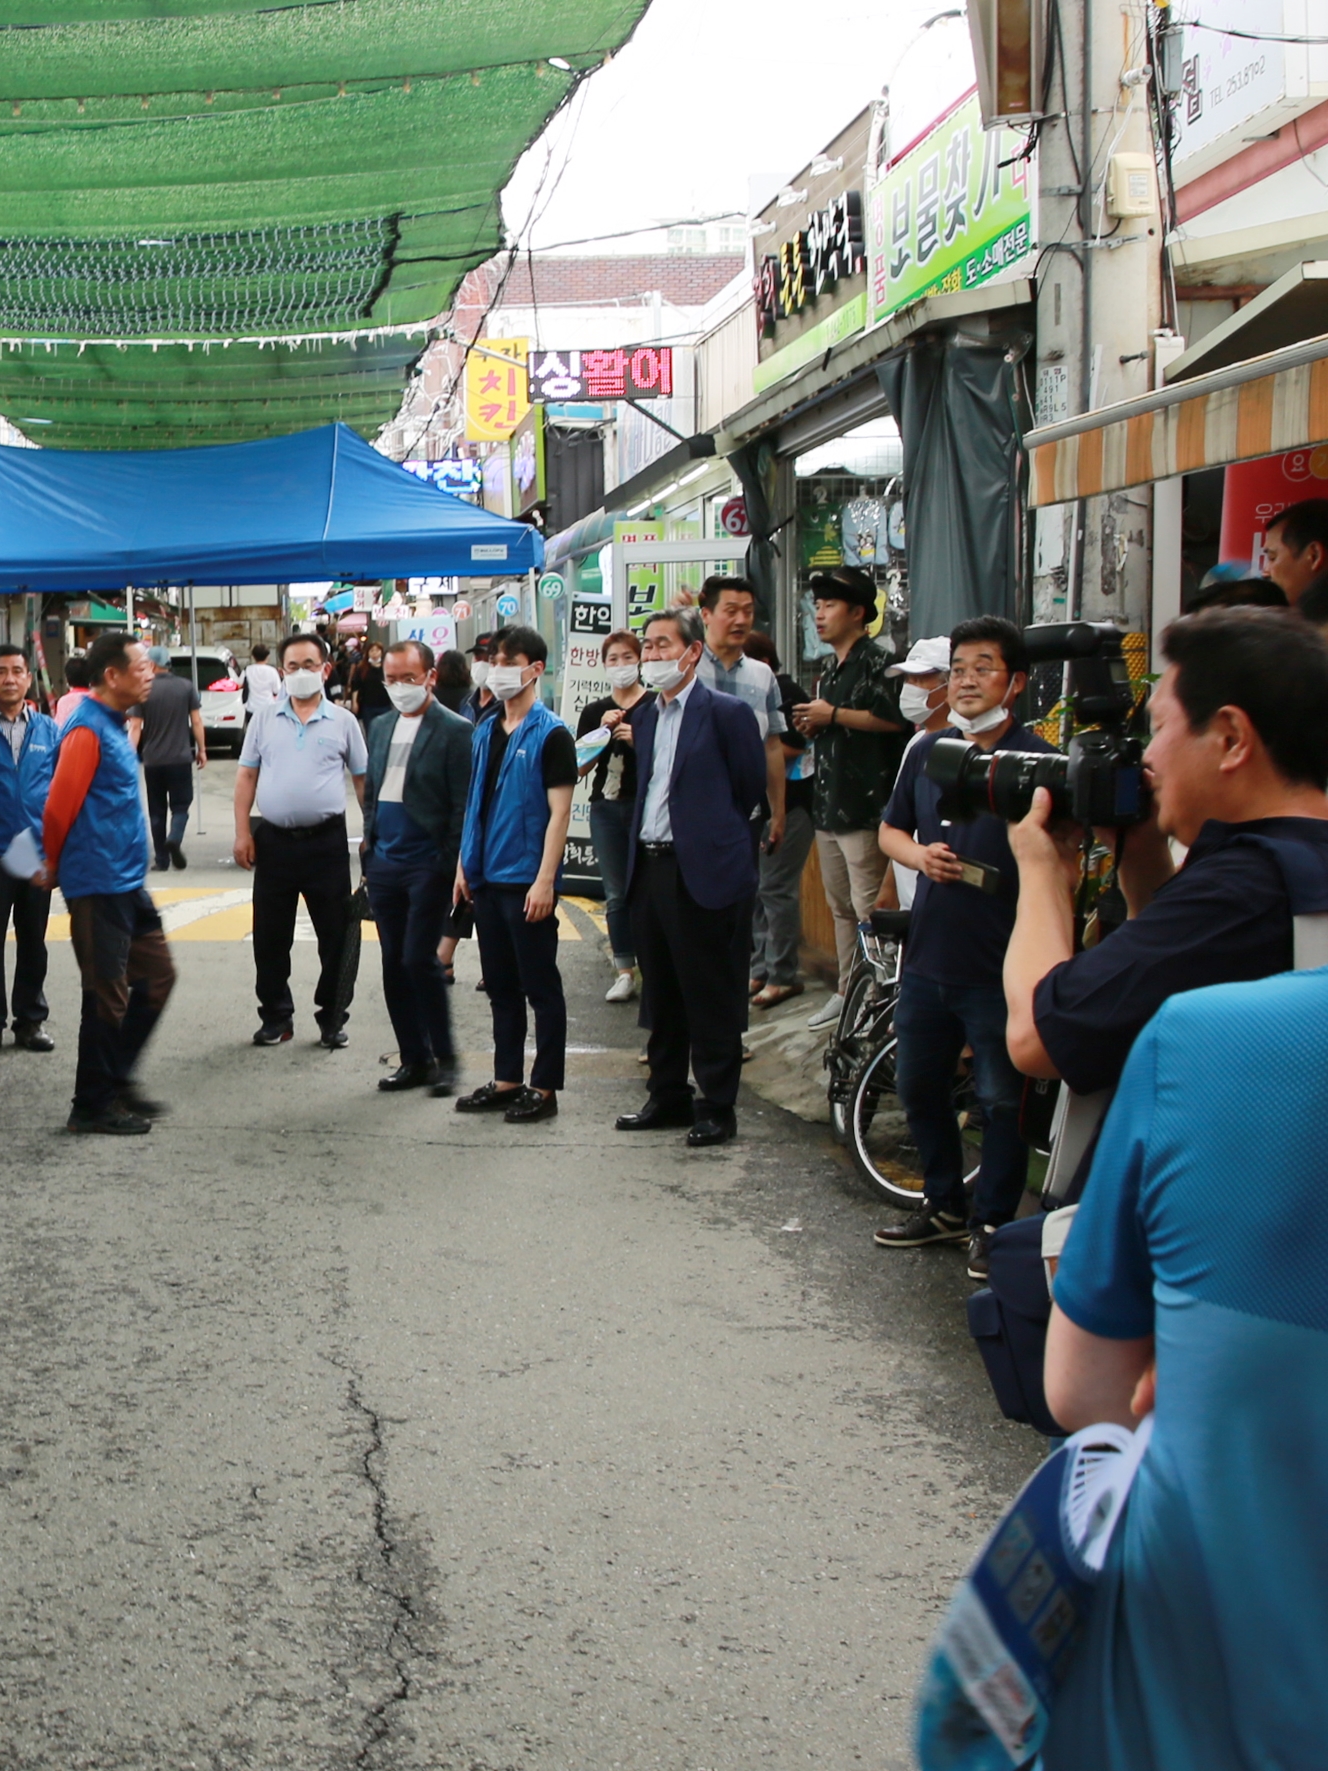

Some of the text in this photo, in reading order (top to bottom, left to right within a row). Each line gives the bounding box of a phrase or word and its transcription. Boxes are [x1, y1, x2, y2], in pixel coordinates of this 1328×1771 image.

[1209, 85, 1224, 108] TEL
[478, 367, 517, 429] 치킨
[543, 581, 561, 594] 69
[501, 602, 517, 612] 70
